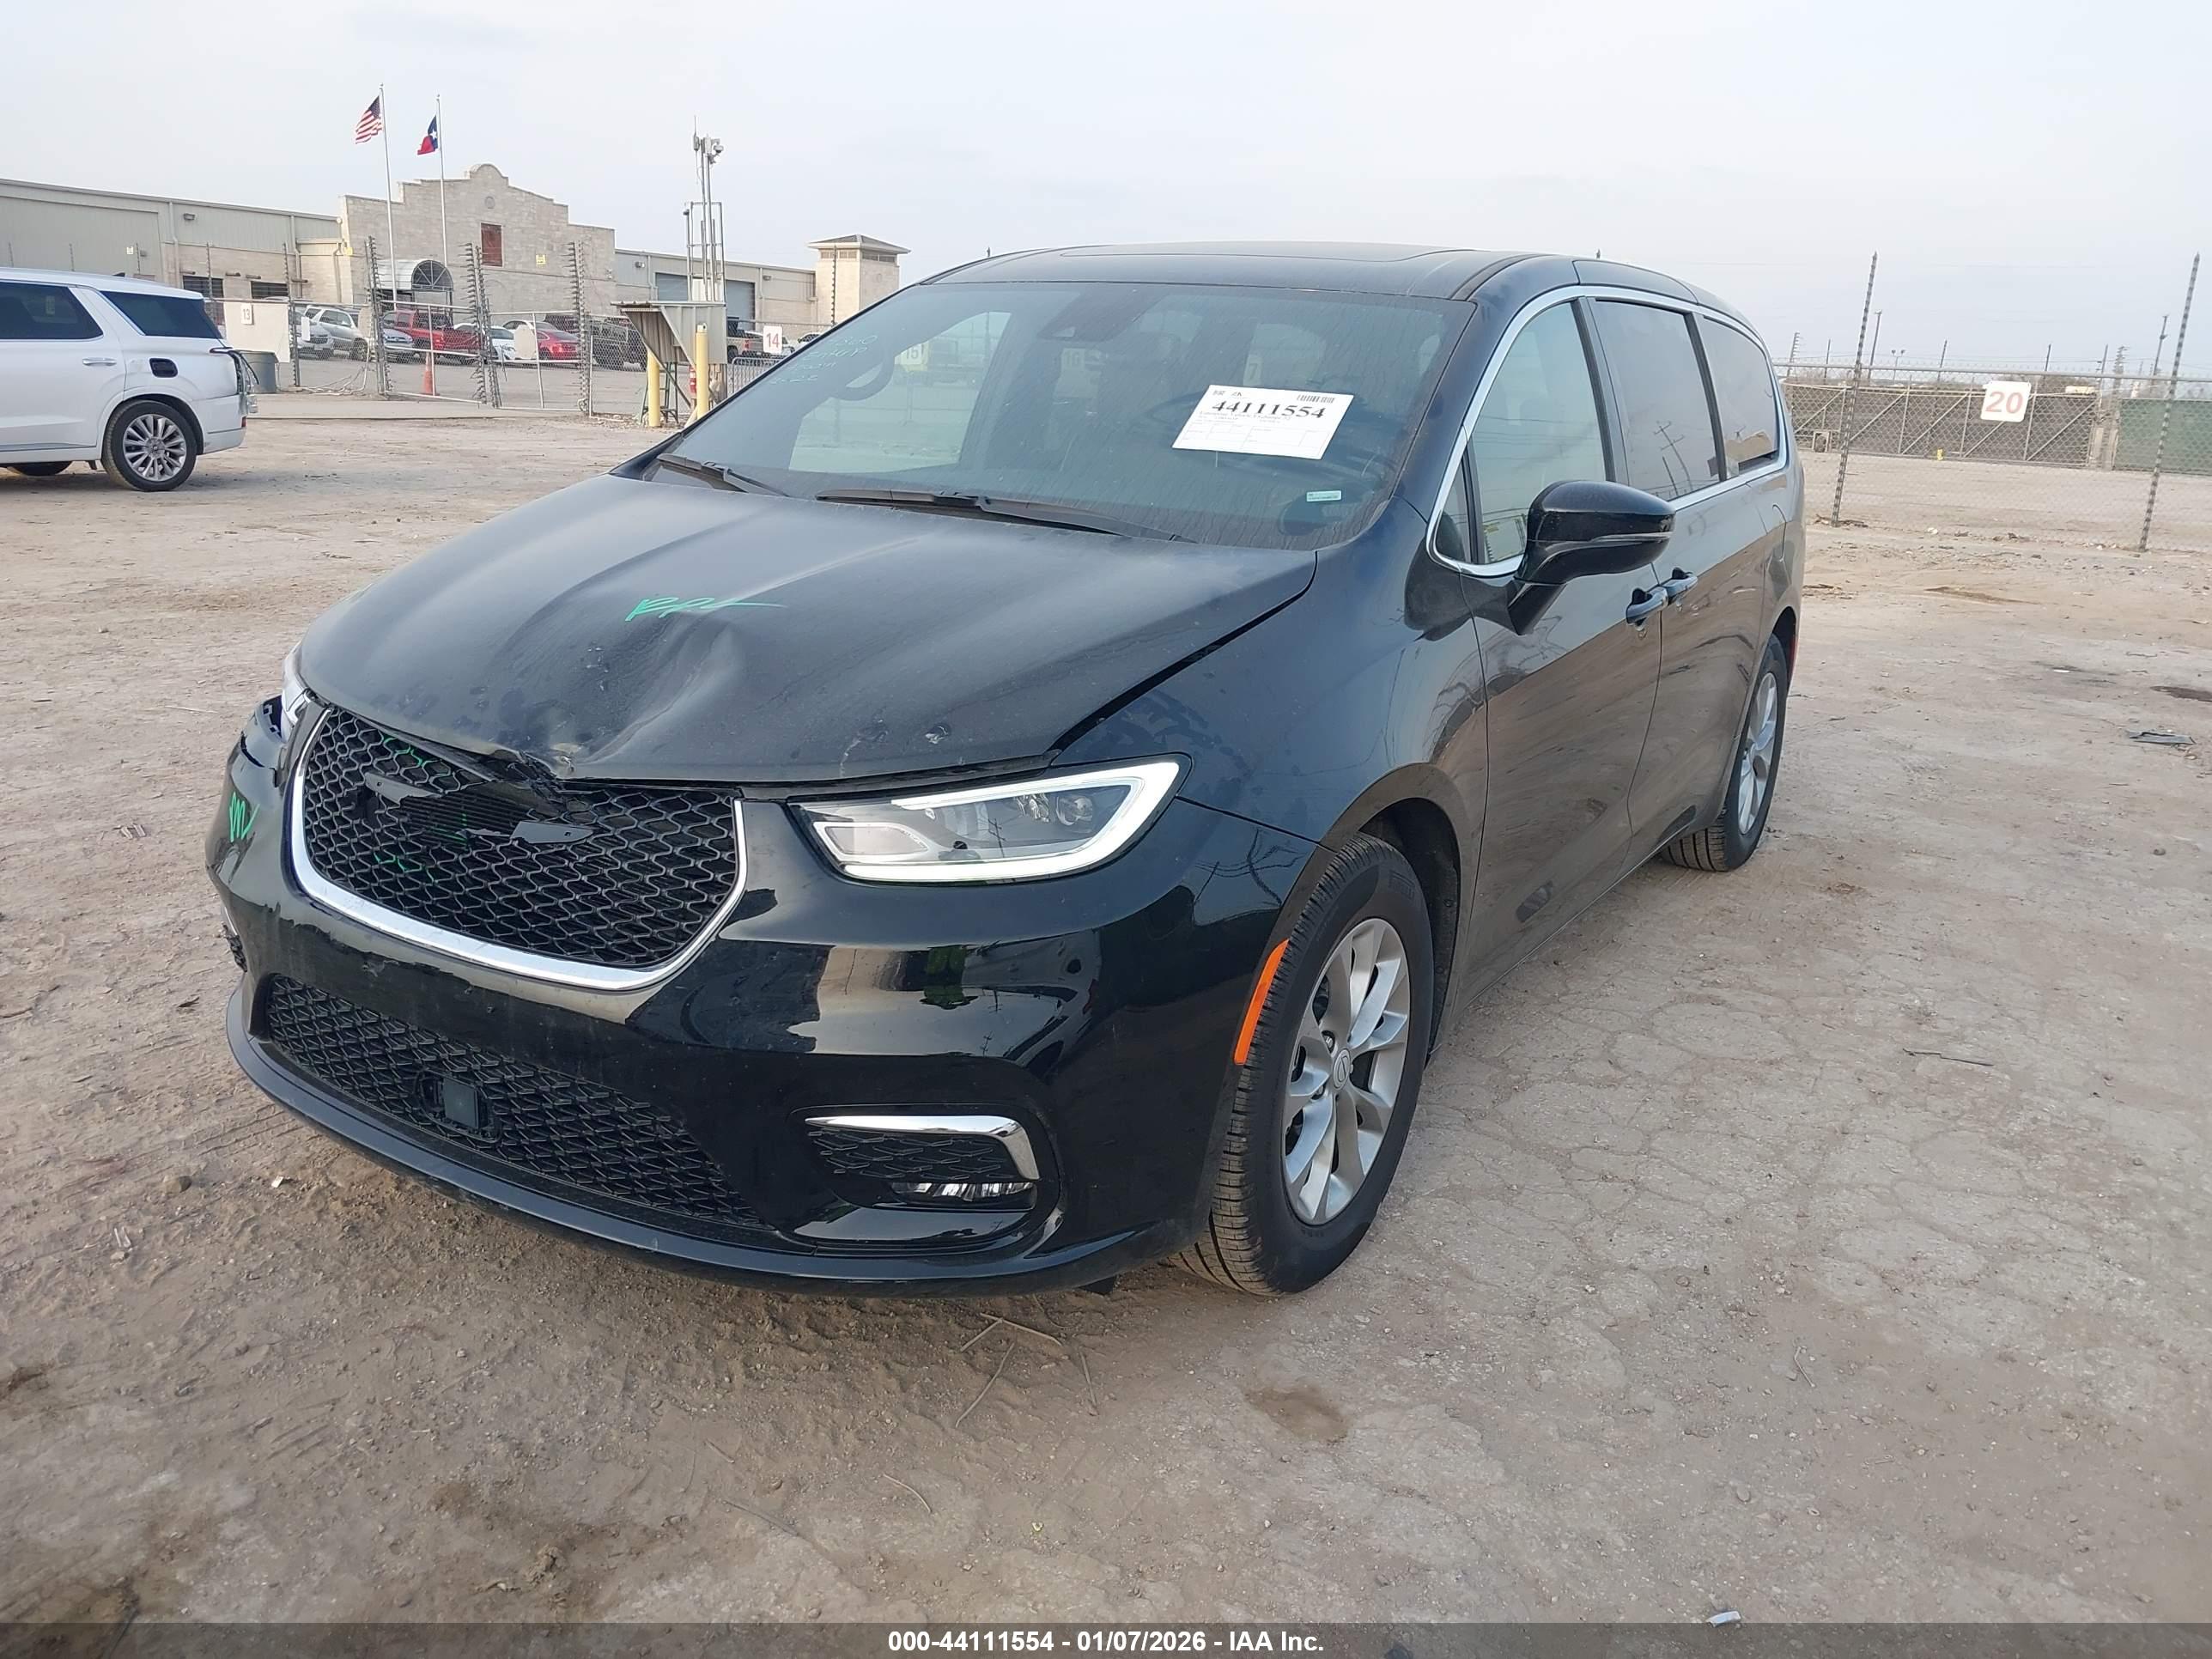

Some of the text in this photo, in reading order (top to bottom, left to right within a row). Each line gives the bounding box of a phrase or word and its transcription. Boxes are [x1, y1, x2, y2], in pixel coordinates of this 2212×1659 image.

[766, 332, 780, 348] 14
[1212, 400, 1326, 418] 44111554
[1984, 391, 2023, 414] 20
